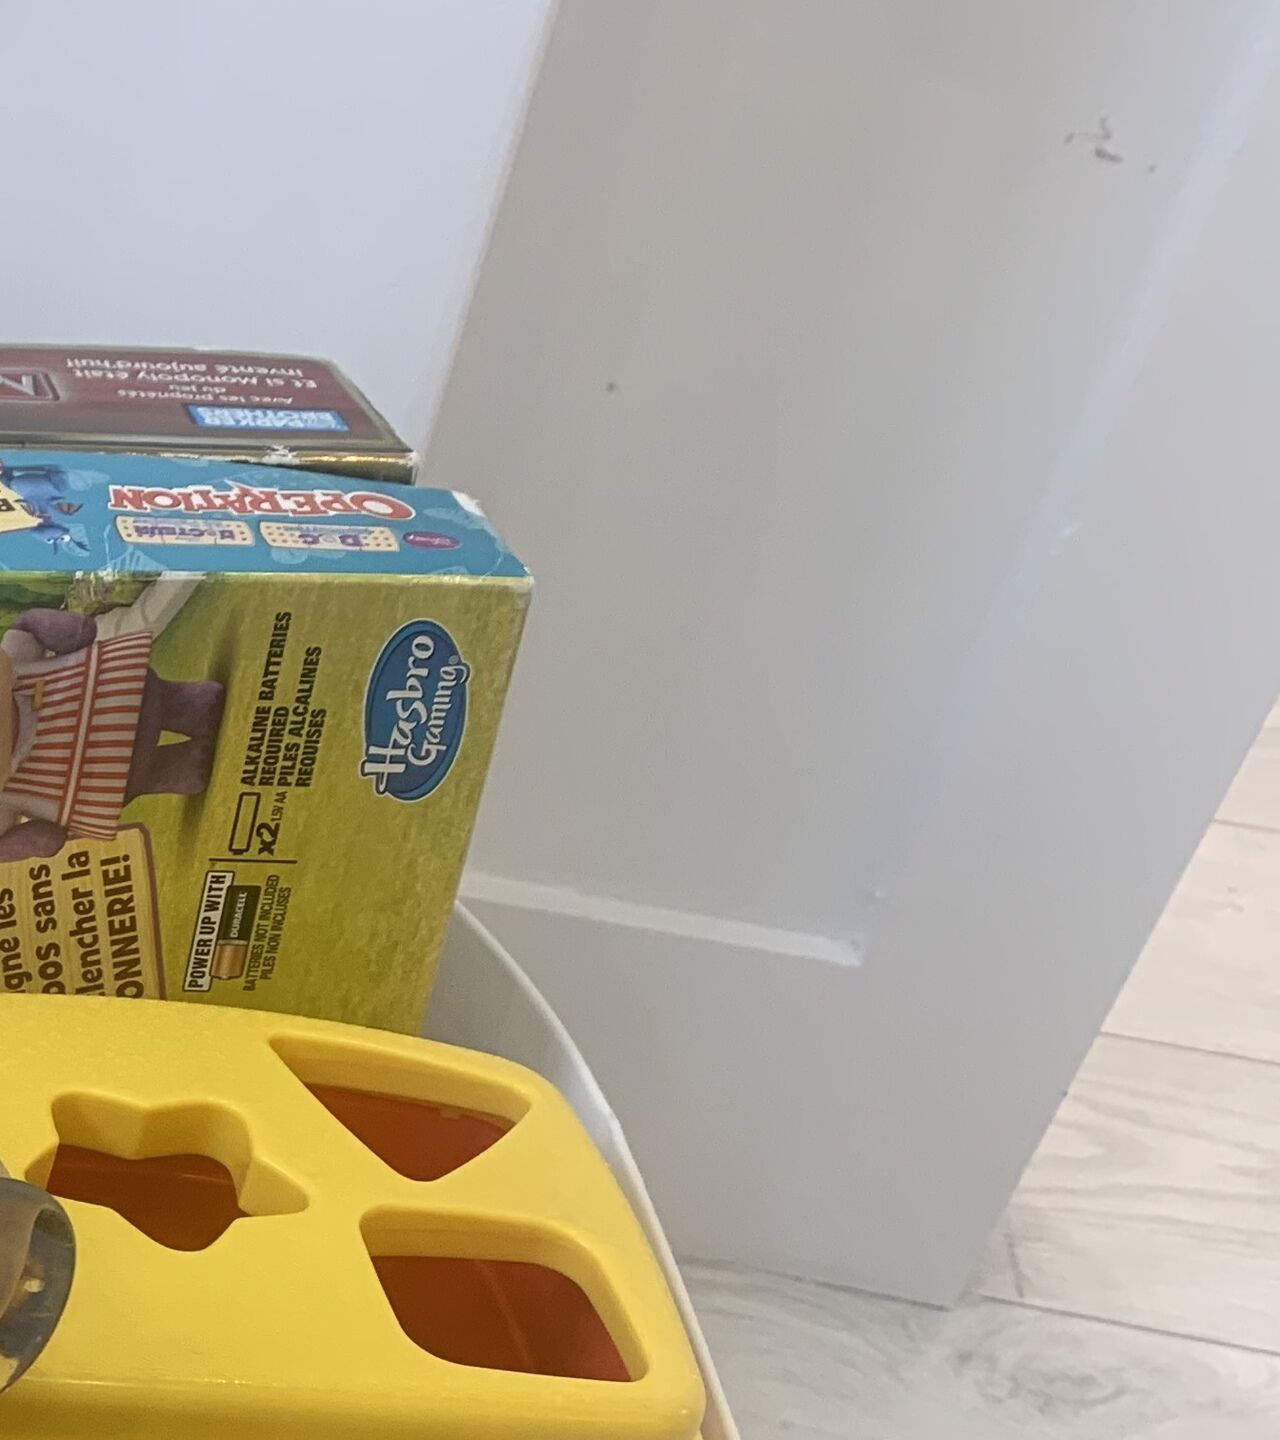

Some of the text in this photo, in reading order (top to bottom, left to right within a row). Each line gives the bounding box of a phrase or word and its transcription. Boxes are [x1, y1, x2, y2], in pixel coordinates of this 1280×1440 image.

[109, 480, 415, 519] OPERATION
[241, 611, 292, 787] ALKALINE BATTERIES
[258, 705, 289, 787] REQUIRED
[276, 645, 322, 787] PILES ALCALINES
[362, 634, 435, 793] Hasbro
[407, 659, 469, 767] Gaming
[294, 707, 327, 788] REQUISES
[60, 850, 92, 881] la
[256, 822, 280, 856] x2
[28, 864, 58, 934] sans
[100, 853, 145, 999] ONNERIE!
[187, 874, 227, 989] POWER UP WITH
[230, 891, 248, 938] DURACELL
[242, 874, 280, 992] BATTERIES NOT INCLUDED
[259, 886, 292, 981] PILES NON INCLUSES
